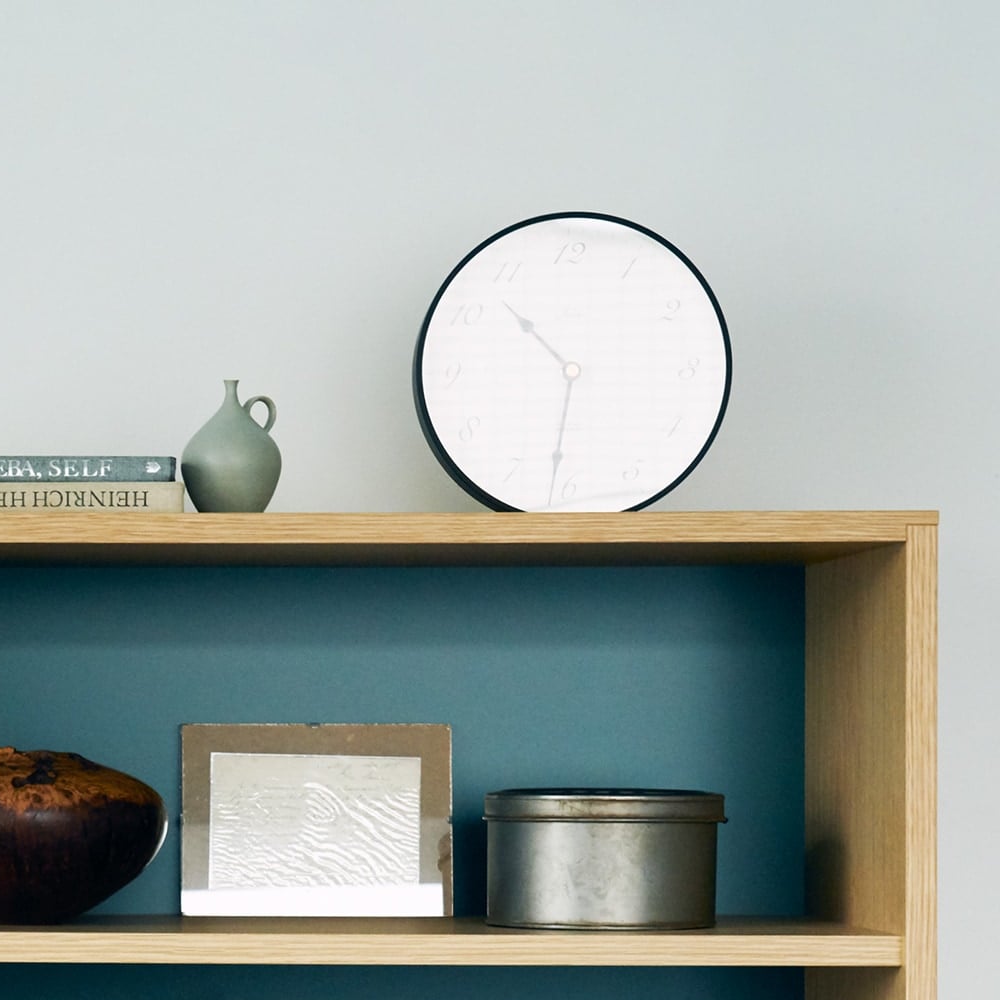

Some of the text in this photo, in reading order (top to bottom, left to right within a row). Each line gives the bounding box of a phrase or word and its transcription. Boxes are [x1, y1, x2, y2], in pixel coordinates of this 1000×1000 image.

[554, 241, 586, 264] 12
[48, 459, 113, 478] SELF
[33, 490, 149, 508] HEINRICH
